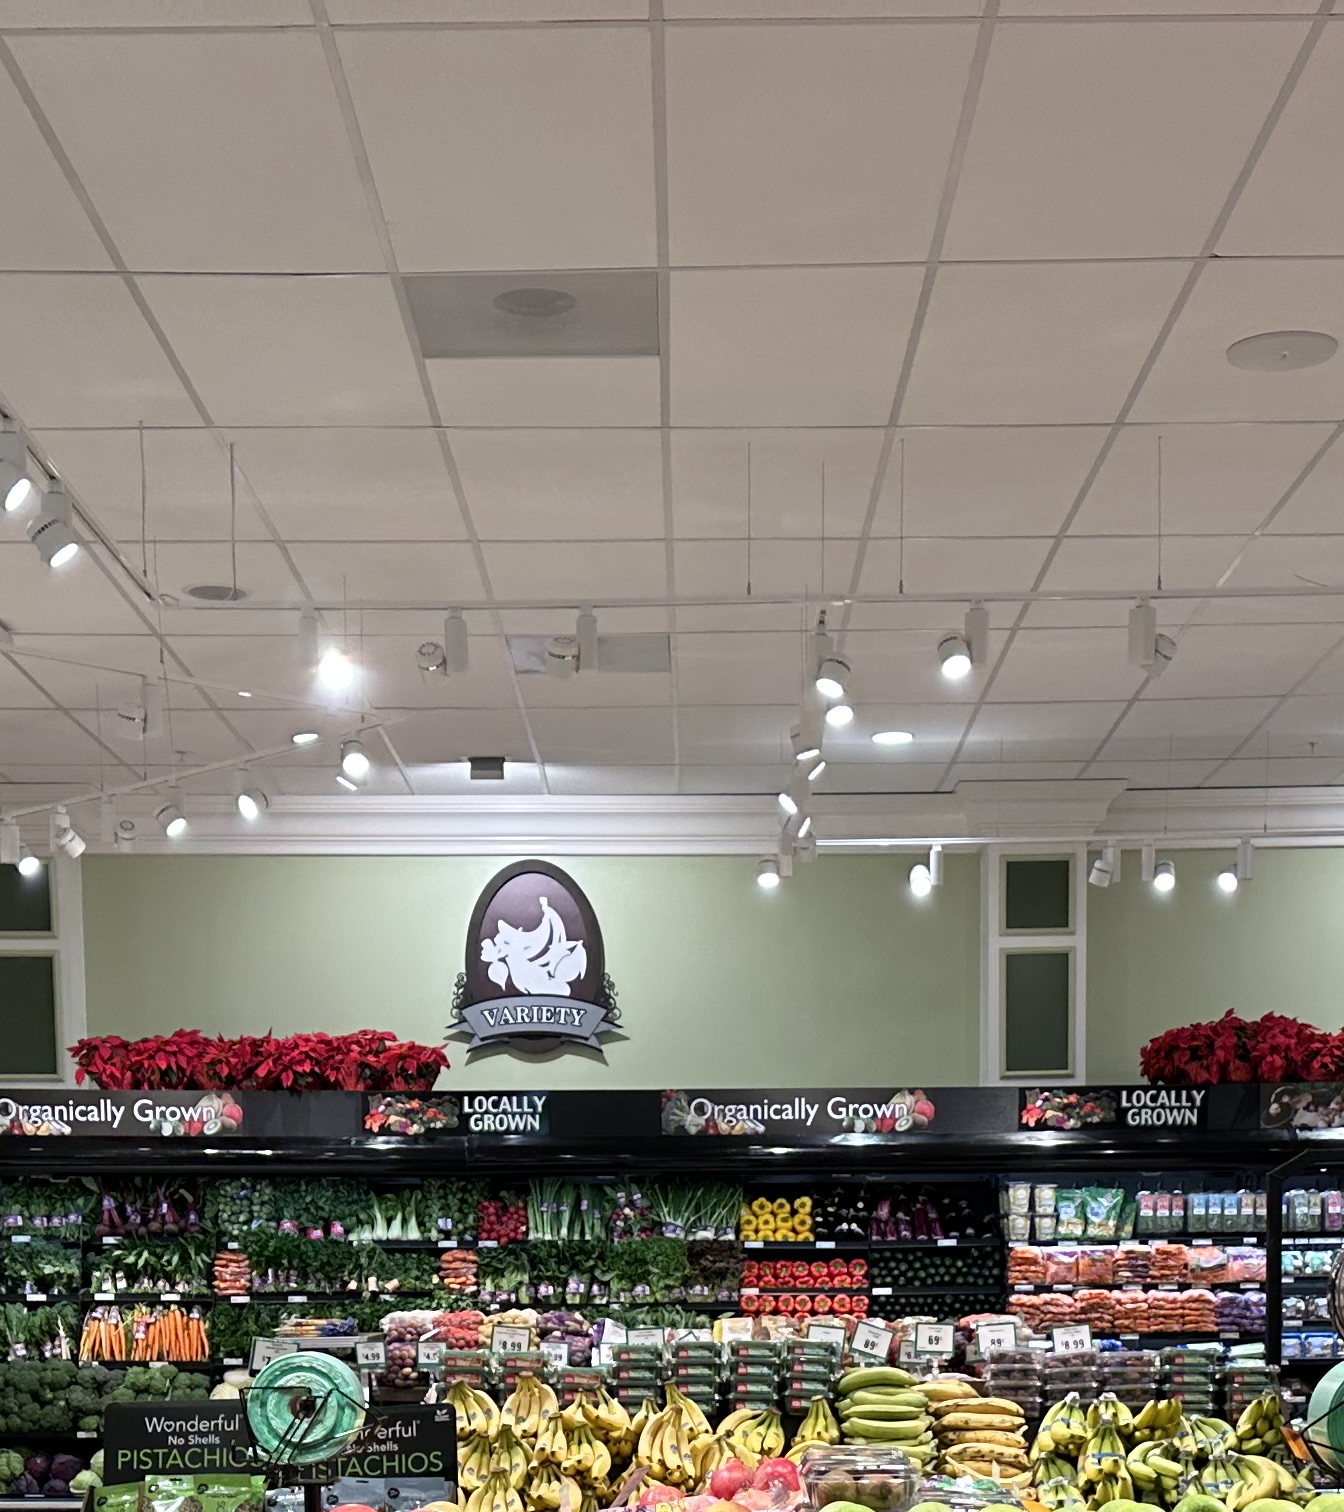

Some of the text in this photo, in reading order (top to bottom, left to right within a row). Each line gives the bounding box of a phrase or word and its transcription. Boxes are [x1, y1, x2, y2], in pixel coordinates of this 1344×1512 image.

[480, 1005, 586, 1027] VARIETY
[463, 1095, 547, 1113] LOCALLY
[1121, 1089, 1206, 1107] LOCALLY
[133, 1099, 216, 1123] Grown
[690, 1096, 908, 1126] Organically Grown
[1126, 1107, 1198, 1126] GROWN
[469, 1113, 541, 1132] GROWN
[145, 1413, 239, 1433] Wonderful
[168, 1434, 220, 1446] No Shells
